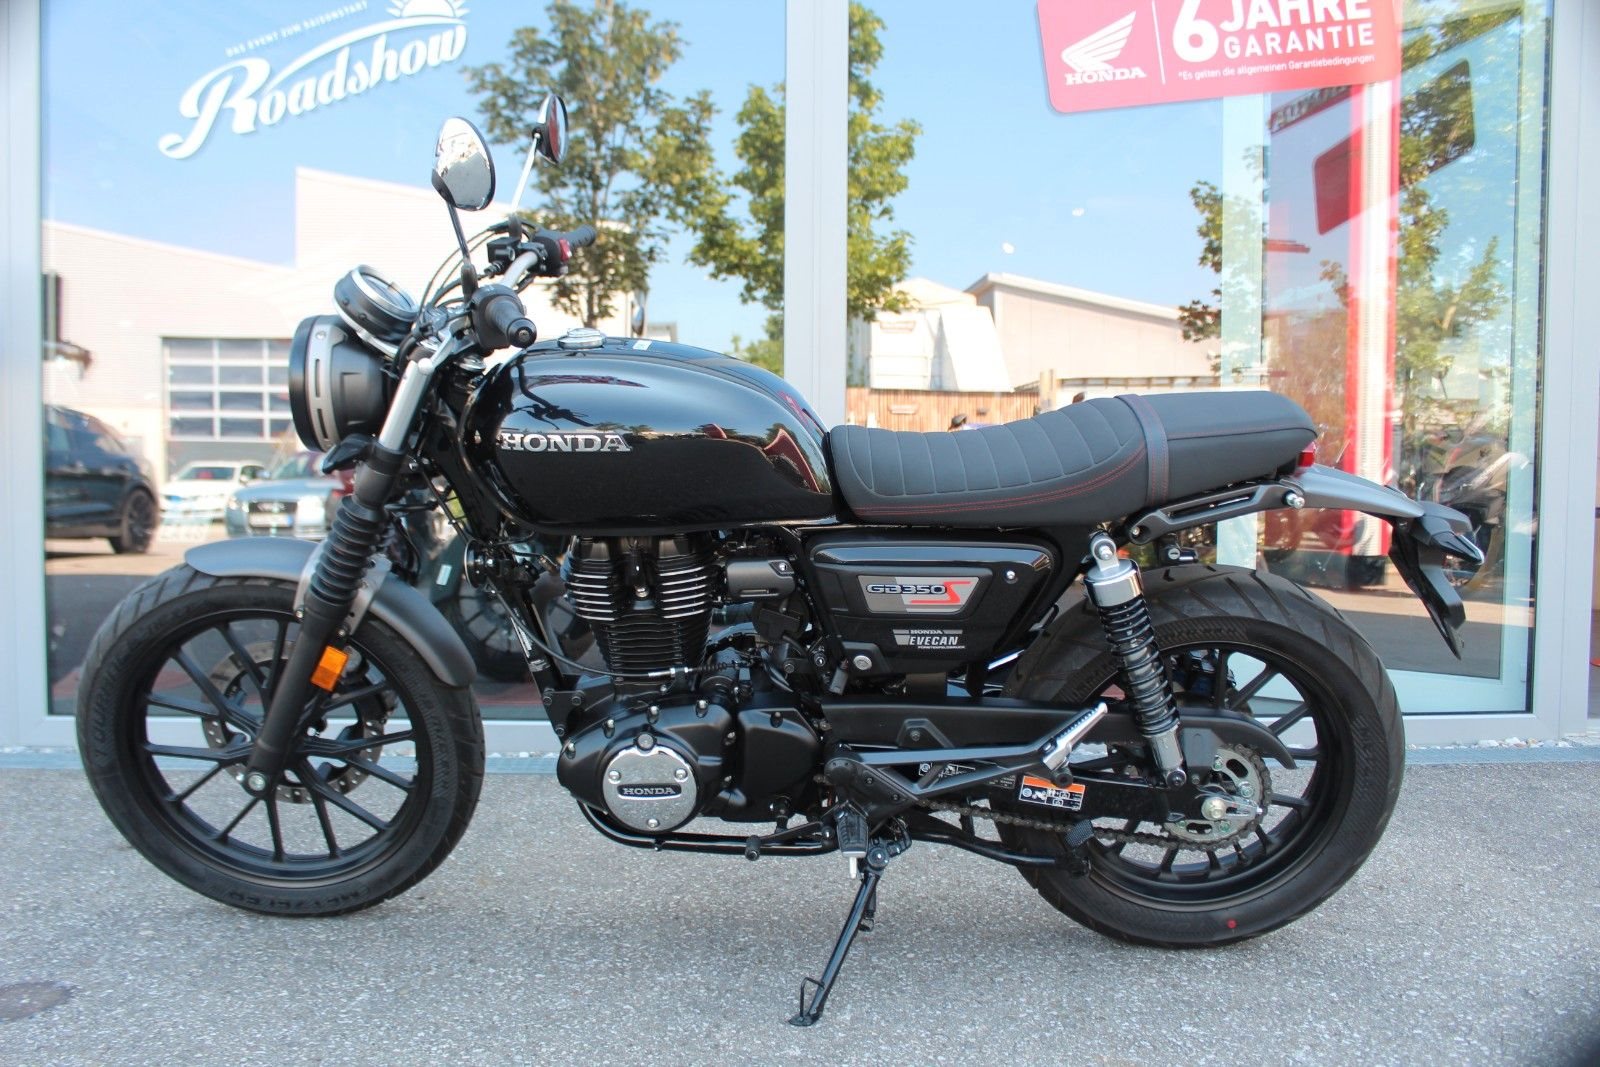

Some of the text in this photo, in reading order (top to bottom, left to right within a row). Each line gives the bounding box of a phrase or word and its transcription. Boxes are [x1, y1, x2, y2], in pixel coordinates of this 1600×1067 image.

[225, 0, 367, 57] DAS EVENT ZUM SAISONSTART
[1172, 0, 1219, 62] 6
[1223, 23, 1374, 59] GARANTIE
[1064, 66, 1147, 85] HONDA
[1195, 69, 1221, 81] gelten
[1222, 66, 1236, 77] die
[1237, 62, 1287, 76] allgemeinen
[158, 24, 467, 160] Roadshow
[500, 432, 632, 452] HONDA
[909, 636, 959, 646] EVECAN
[622, 786, 676, 796] HONDA
